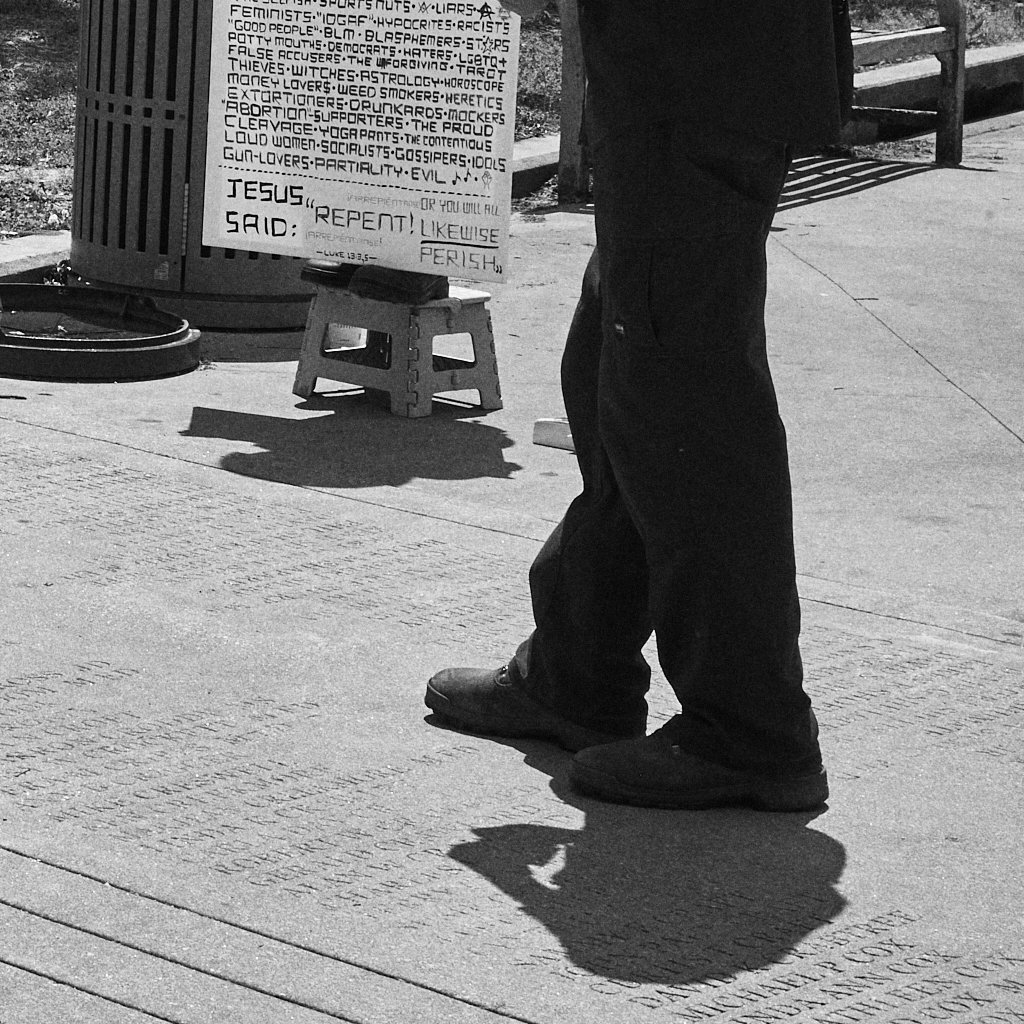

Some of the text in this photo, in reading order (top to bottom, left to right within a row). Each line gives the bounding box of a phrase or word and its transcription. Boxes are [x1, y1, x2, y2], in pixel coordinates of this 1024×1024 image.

[230, 4, 312, 23] FEMINISTS
[377, 16, 453, 31] HYPOCRITES
[457, 20, 511, 35] RACISTS
[435, 2, 475, 17] LIARS
[228, 31, 508, 69] POTTY MOUTHS DEMOCRATS HATERS LGBTQ+
[323, 26, 356, 41] BLM
[364, 28, 463, 48] BLASPHEMERS
[227, 56, 505, 93] THIEVES WITCHES ASTROLOGY HOROSCOPE
[228, 44, 274, 61] FALSE
[278, 49, 342, 65] ACCUSERS
[347, 55, 373, 67] THE
[455, 63, 507, 81] TAROT
[227, 73, 280, 89] MONEY
[337, 83, 377, 98] WEED
[379, 86, 441, 103] SMOKERS
[445, 92, 504, 110] HERETICS
[227, 86, 506, 125] EXTORTIONERS DRUNKARDS MOCKERS
[224, 114, 493, 153] CLEAVAGE YOGA PANTS THE CONTENTIOUS
[410, 118, 438, 133] THE
[442, 121, 494, 138] PROUD
[223, 146, 447, 185] GUN-LOVERS PARTIALITY EVIL
[224, 129, 507, 173] LOUD WOMEN SOCIALISTS GOSSIPERS IDOLS
[226, 178, 304, 206] JESUS
[420, 197, 500, 217] OR YOU WILL ALL
[226, 210, 297, 237] SAID:
[420, 218, 500, 244] LIKEWISE
